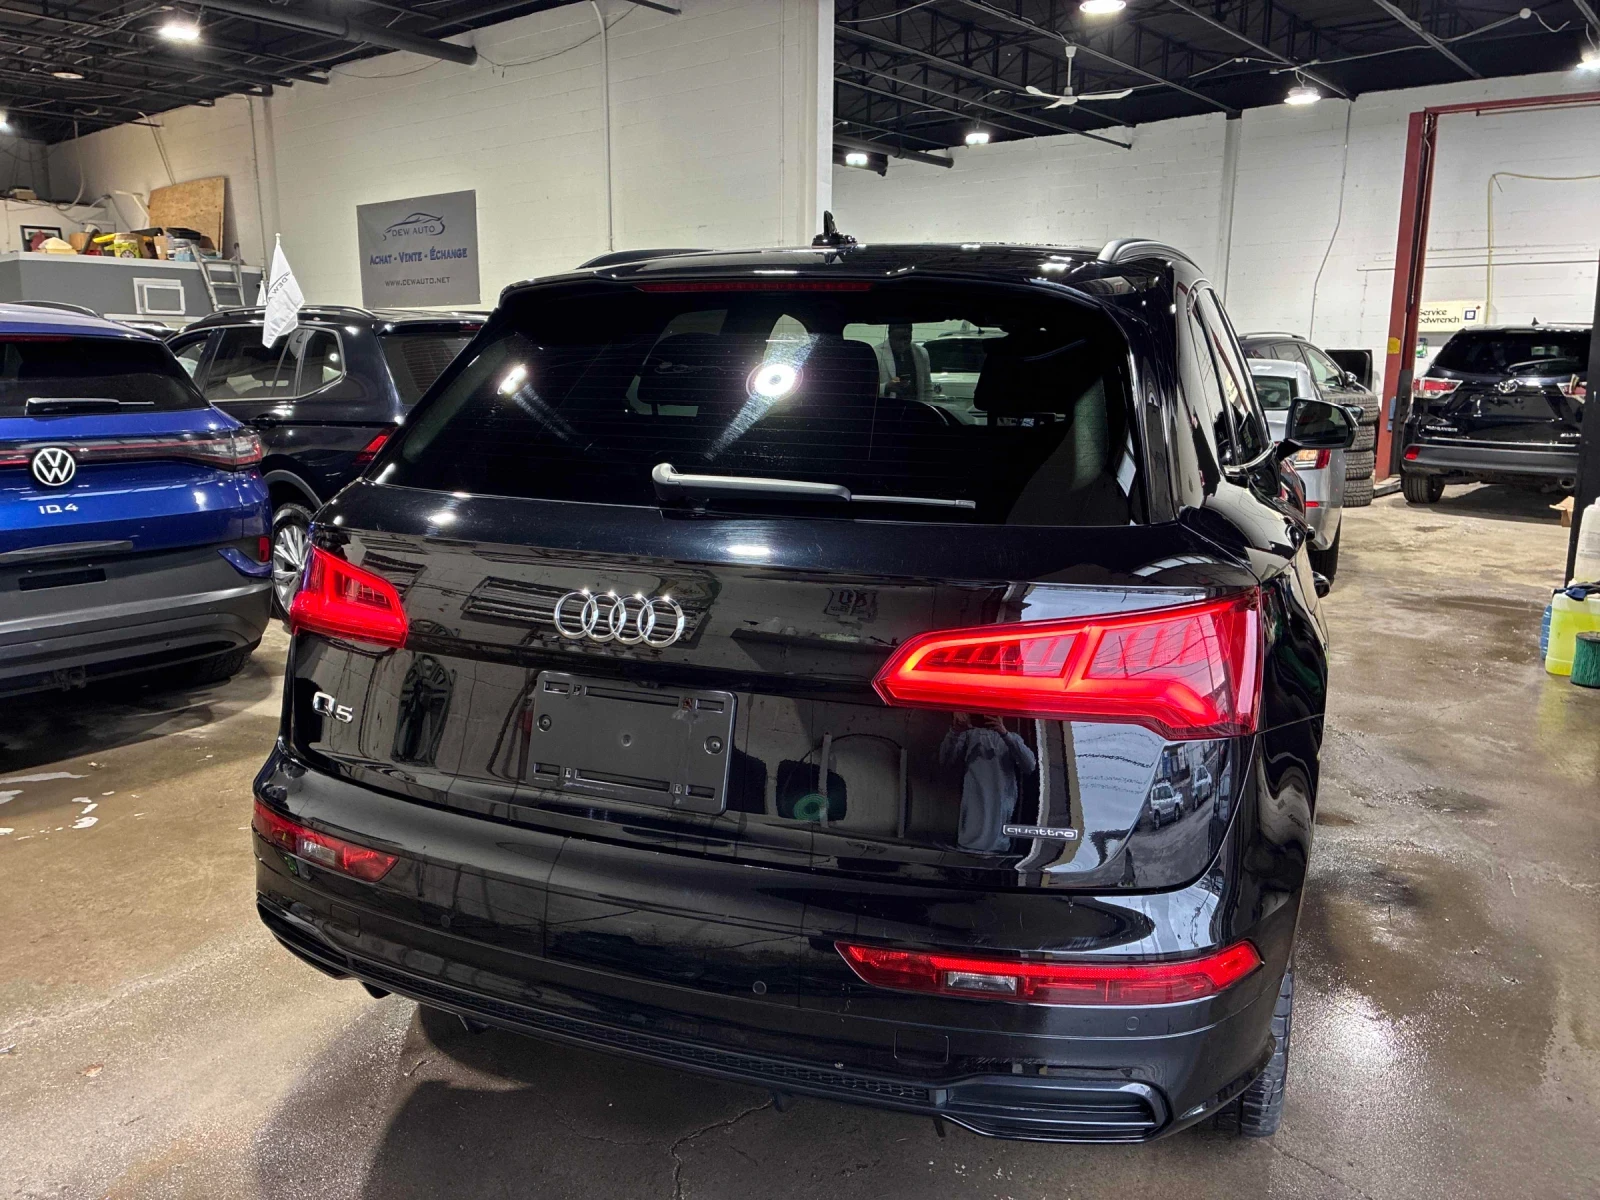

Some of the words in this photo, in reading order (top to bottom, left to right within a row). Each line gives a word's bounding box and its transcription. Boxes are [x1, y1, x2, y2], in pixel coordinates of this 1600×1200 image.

[392, 228, 410, 237] DEW
[413, 225, 435, 235] AUTO
[370, 254, 392, 265] ACHAT
[398, 251, 422, 263] VENTE
[429, 246, 468, 261] ÉCHANGE
[1419, 307, 1447, 316] Service
[33, 448, 75, 486] VW
[313, 691, 353, 723] Q5
[1006, 827, 1075, 838] quattro
